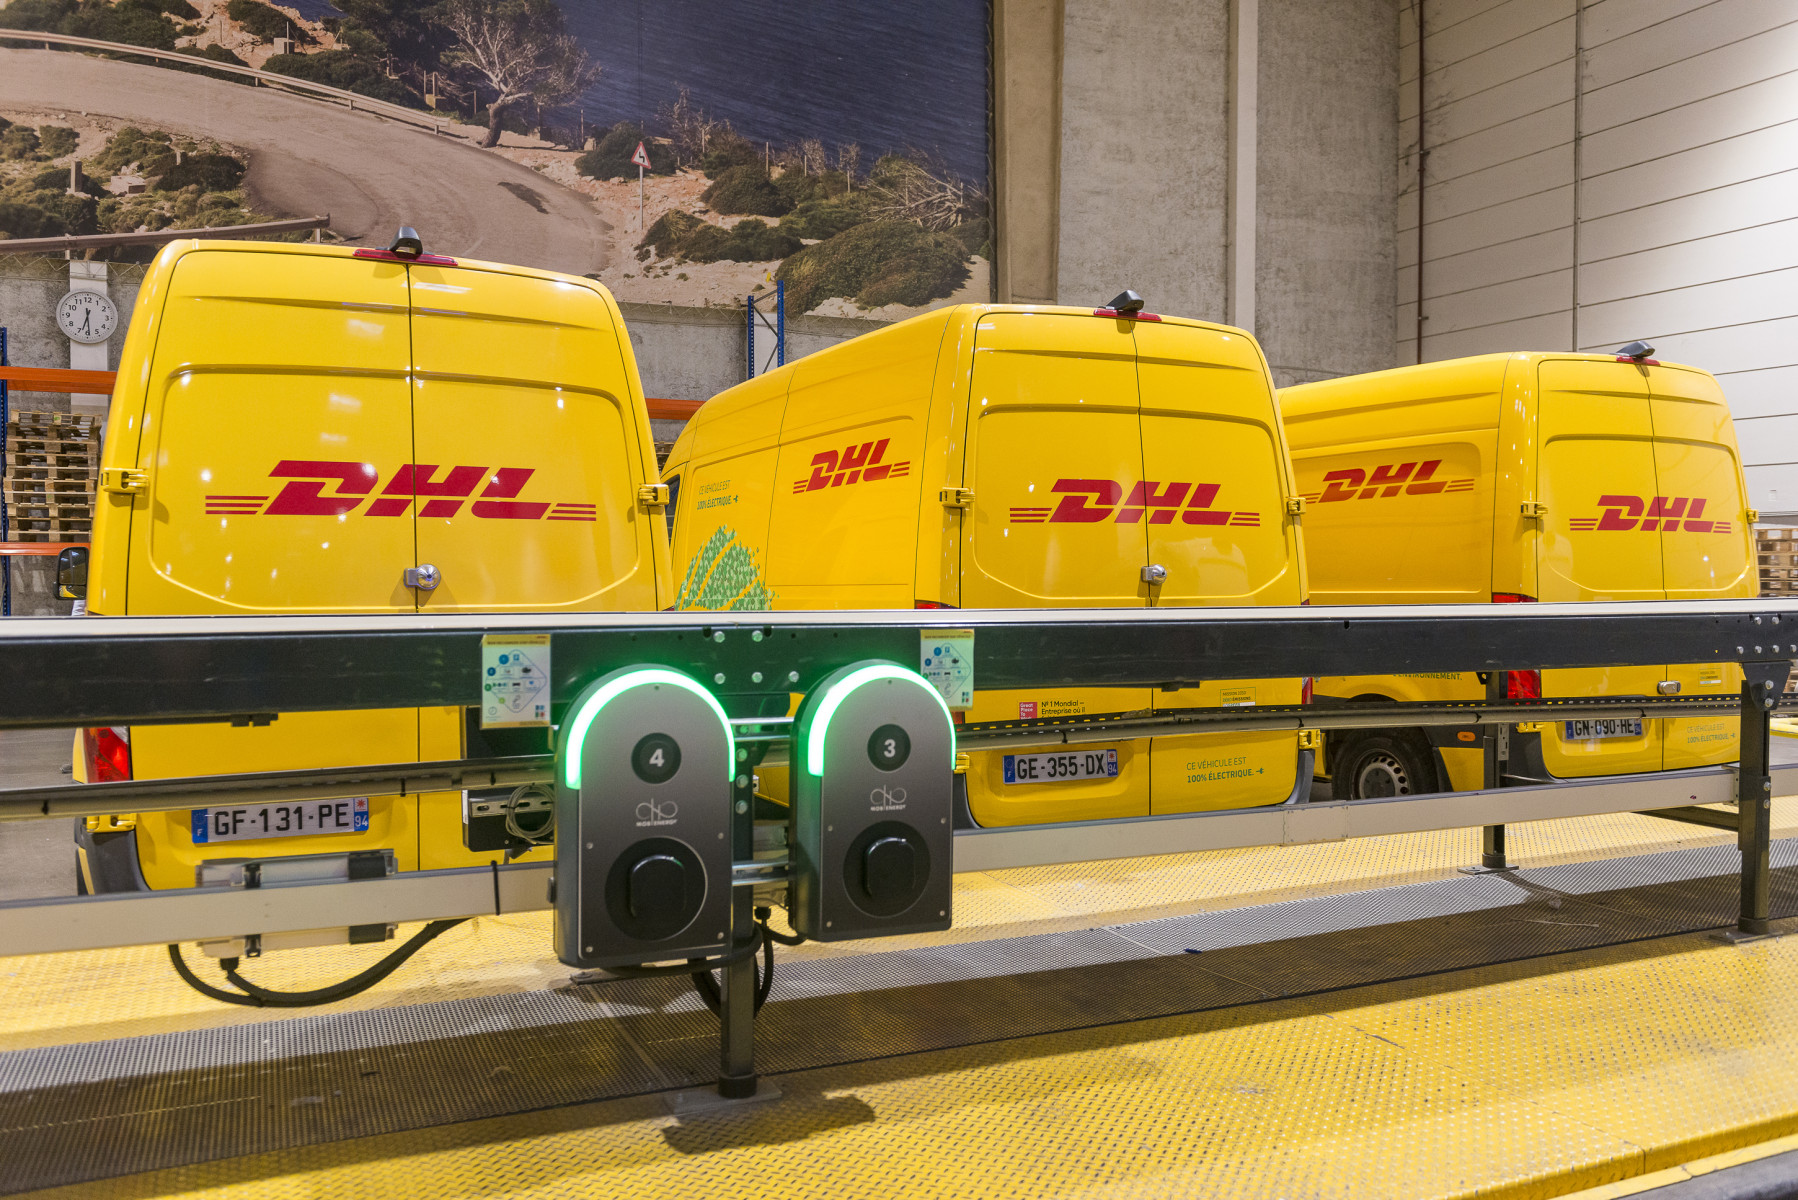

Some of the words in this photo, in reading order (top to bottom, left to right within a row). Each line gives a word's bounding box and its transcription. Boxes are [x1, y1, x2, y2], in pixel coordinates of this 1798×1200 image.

[806, 438, 892, 491] DHL
[264, 460, 551, 519] DHL
[1319, 460, 1447, 503] DHL
[1049, 479, 1232, 525] DHL
[1597, 495, 1713, 532] DHL
[1574, 720, 1634, 736] GN-090-HE
[649, 748, 664, 767] 4
[884, 738, 896, 758] 3
[1017, 754, 1105, 780] GE-355-DX
[1108, 763, 1117, 774] 94
[1187, 762, 1196, 770] CE
[1197, 758, 1232, 770] VÉHICULE
[1233, 757, 1246, 765] EST
[1187, 774, 1207, 783] 100%
[1208, 768, 1254, 781] ÉLECTRIQUE.
[197, 828, 202, 836] F
[214, 803, 349, 836] GF-131-PE
[354, 814, 368, 827] 94
